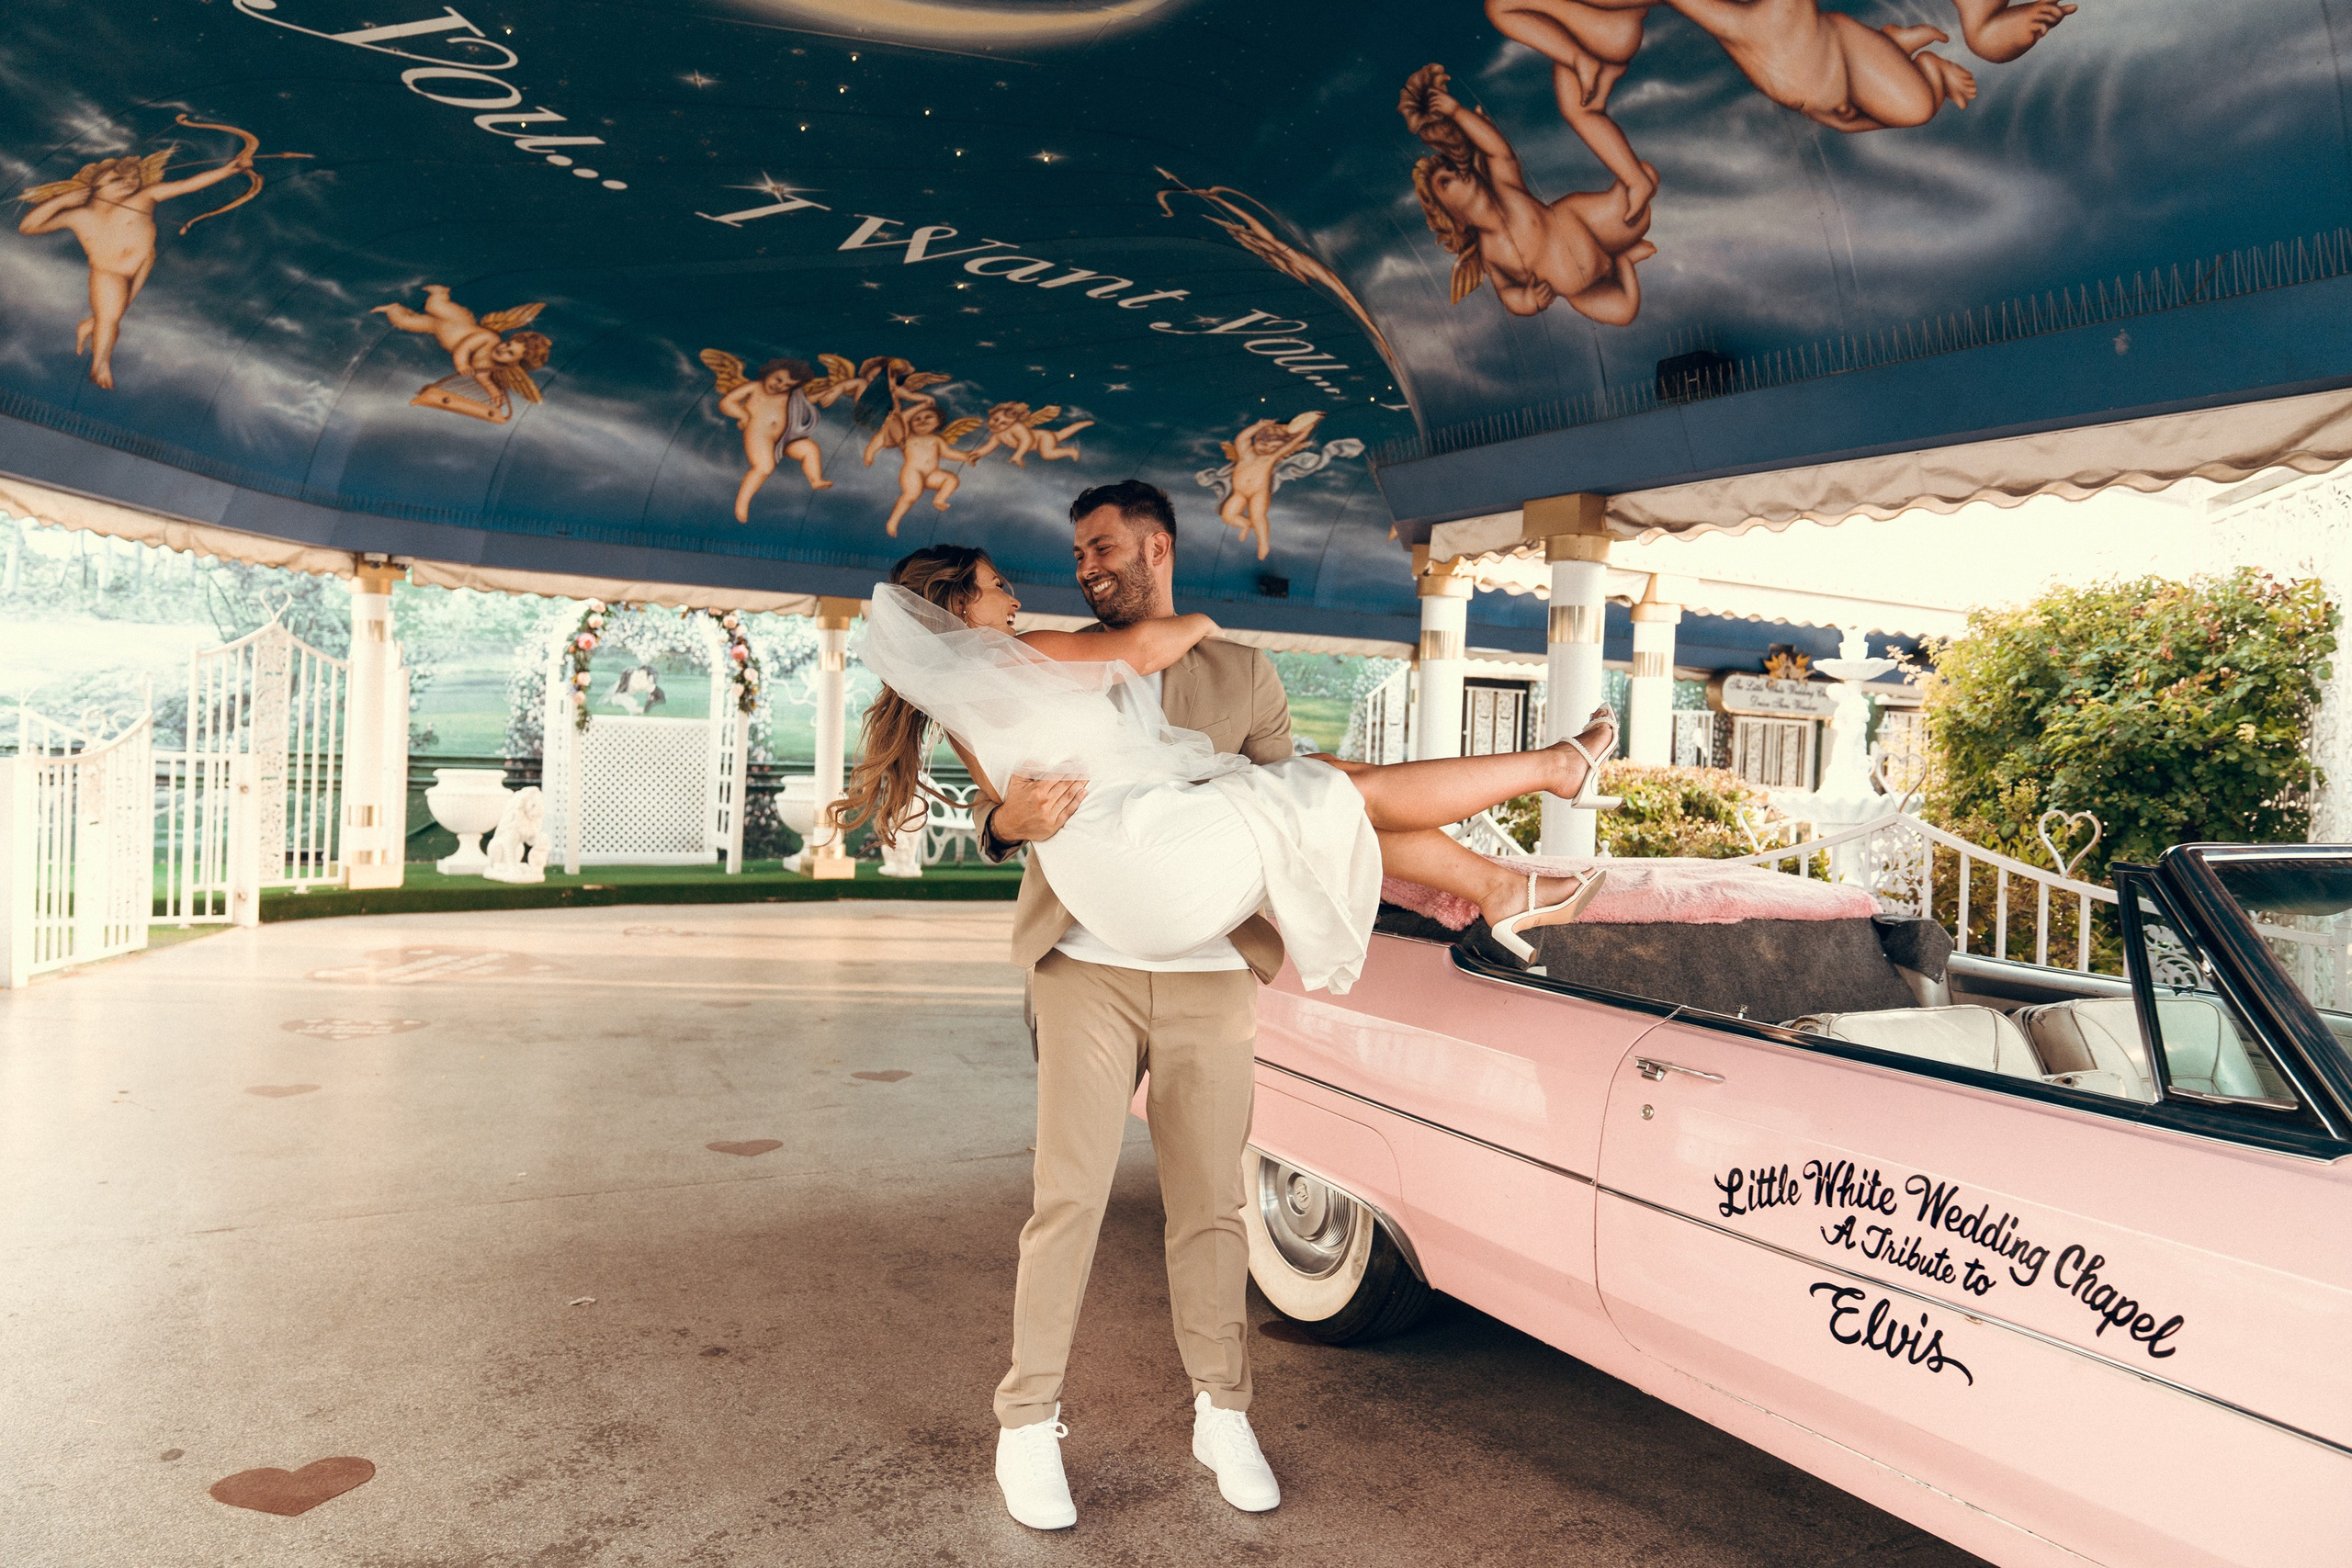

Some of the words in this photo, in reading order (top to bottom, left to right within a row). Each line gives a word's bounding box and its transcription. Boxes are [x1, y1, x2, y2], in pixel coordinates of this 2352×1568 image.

[695, 195, 831, 227] I
[839, 216, 1190, 308] Want
[1714, 1164, 1802, 1218] Little
[1804, 1160, 1897, 1216] White
[1905, 1175, 2051, 1287] Wedding
[2054, 1245, 2185, 1359] Chapel
[1821, 1215, 1857, 1250] A
[1861, 1225, 1957, 1285] Tribute
[1962, 1247, 1997, 1296] to
[1810, 1283, 1973, 1387] Elvis
